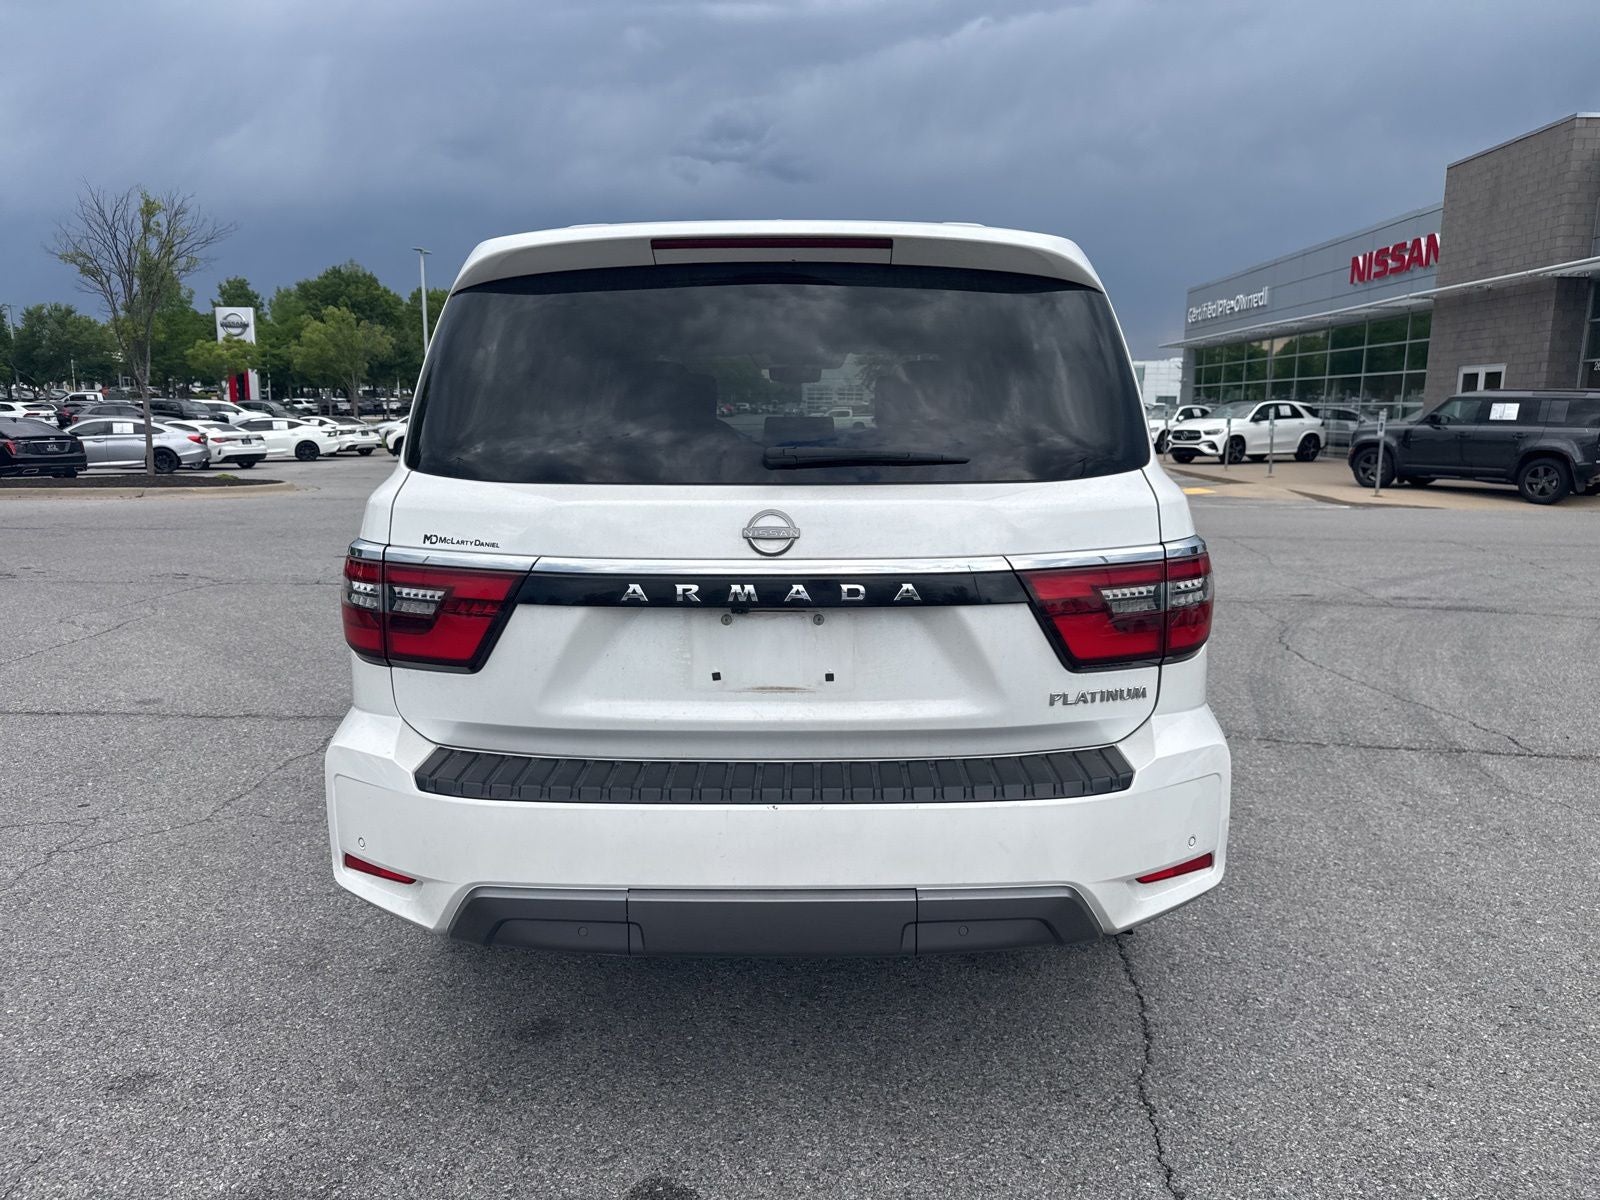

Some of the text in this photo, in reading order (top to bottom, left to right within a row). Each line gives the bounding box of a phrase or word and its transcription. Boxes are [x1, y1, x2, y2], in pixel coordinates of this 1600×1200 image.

[1349, 233, 1440, 285] NISSAN
[743, 529, 799, 537] NISSAN
[620, 583, 922, 602] ARMADA
[1049, 686, 1147, 706] PLATINUM
